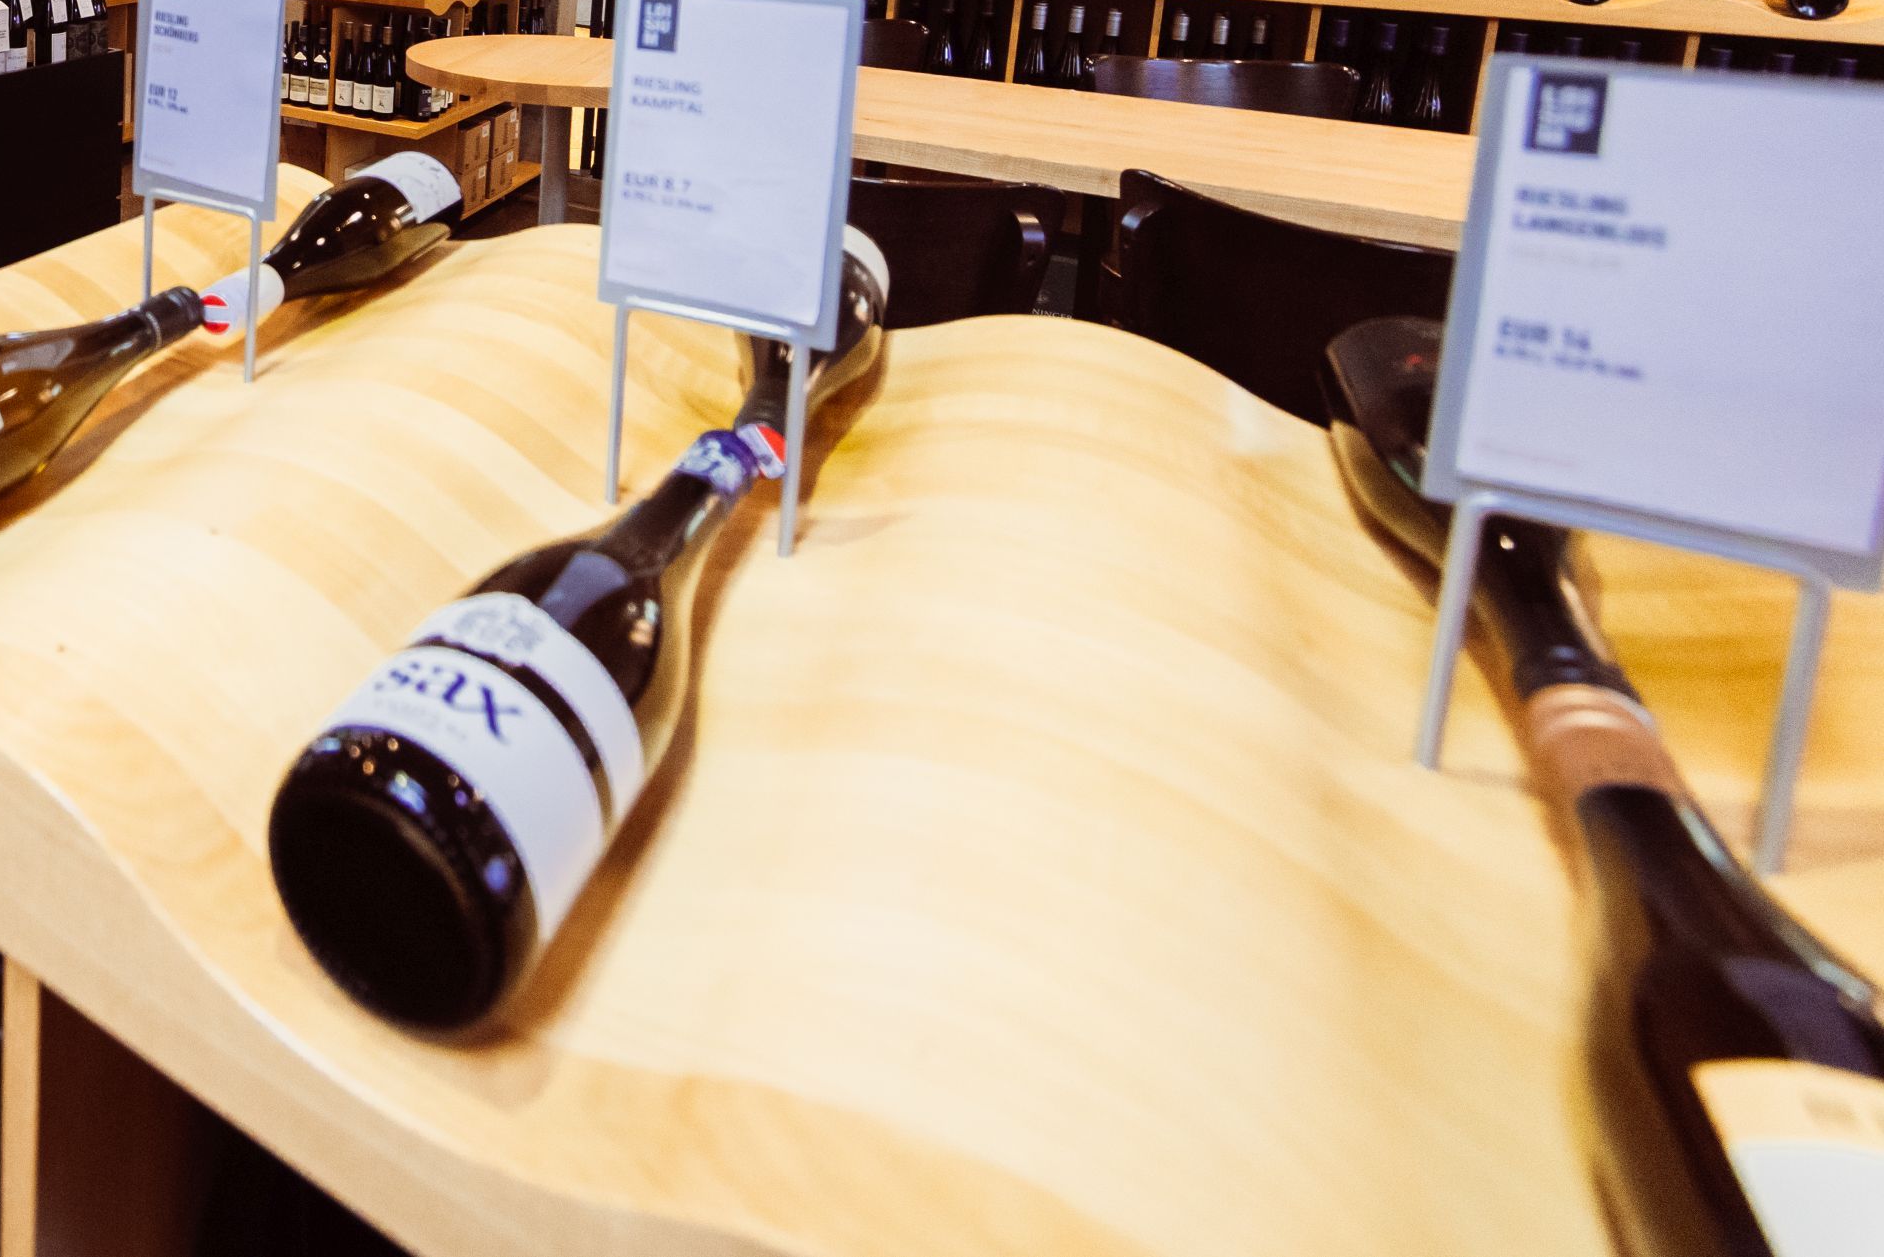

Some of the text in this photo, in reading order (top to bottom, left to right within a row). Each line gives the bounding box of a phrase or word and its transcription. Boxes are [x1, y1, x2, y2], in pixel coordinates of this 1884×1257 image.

[154, 9, 189, 28] RIESLING
[153, 25, 199, 44] SCHÖNBERG
[149, 83, 179, 102] EUR 12
[632, 74, 702, 96] RIESLING
[631, 93, 704, 115] KAMPTAL
[623, 171, 659, 189] EUR
[1515, 184, 1629, 215] RIESLING
[1498, 314, 1550, 345] EUR
[373, 659, 523, 745] sax
